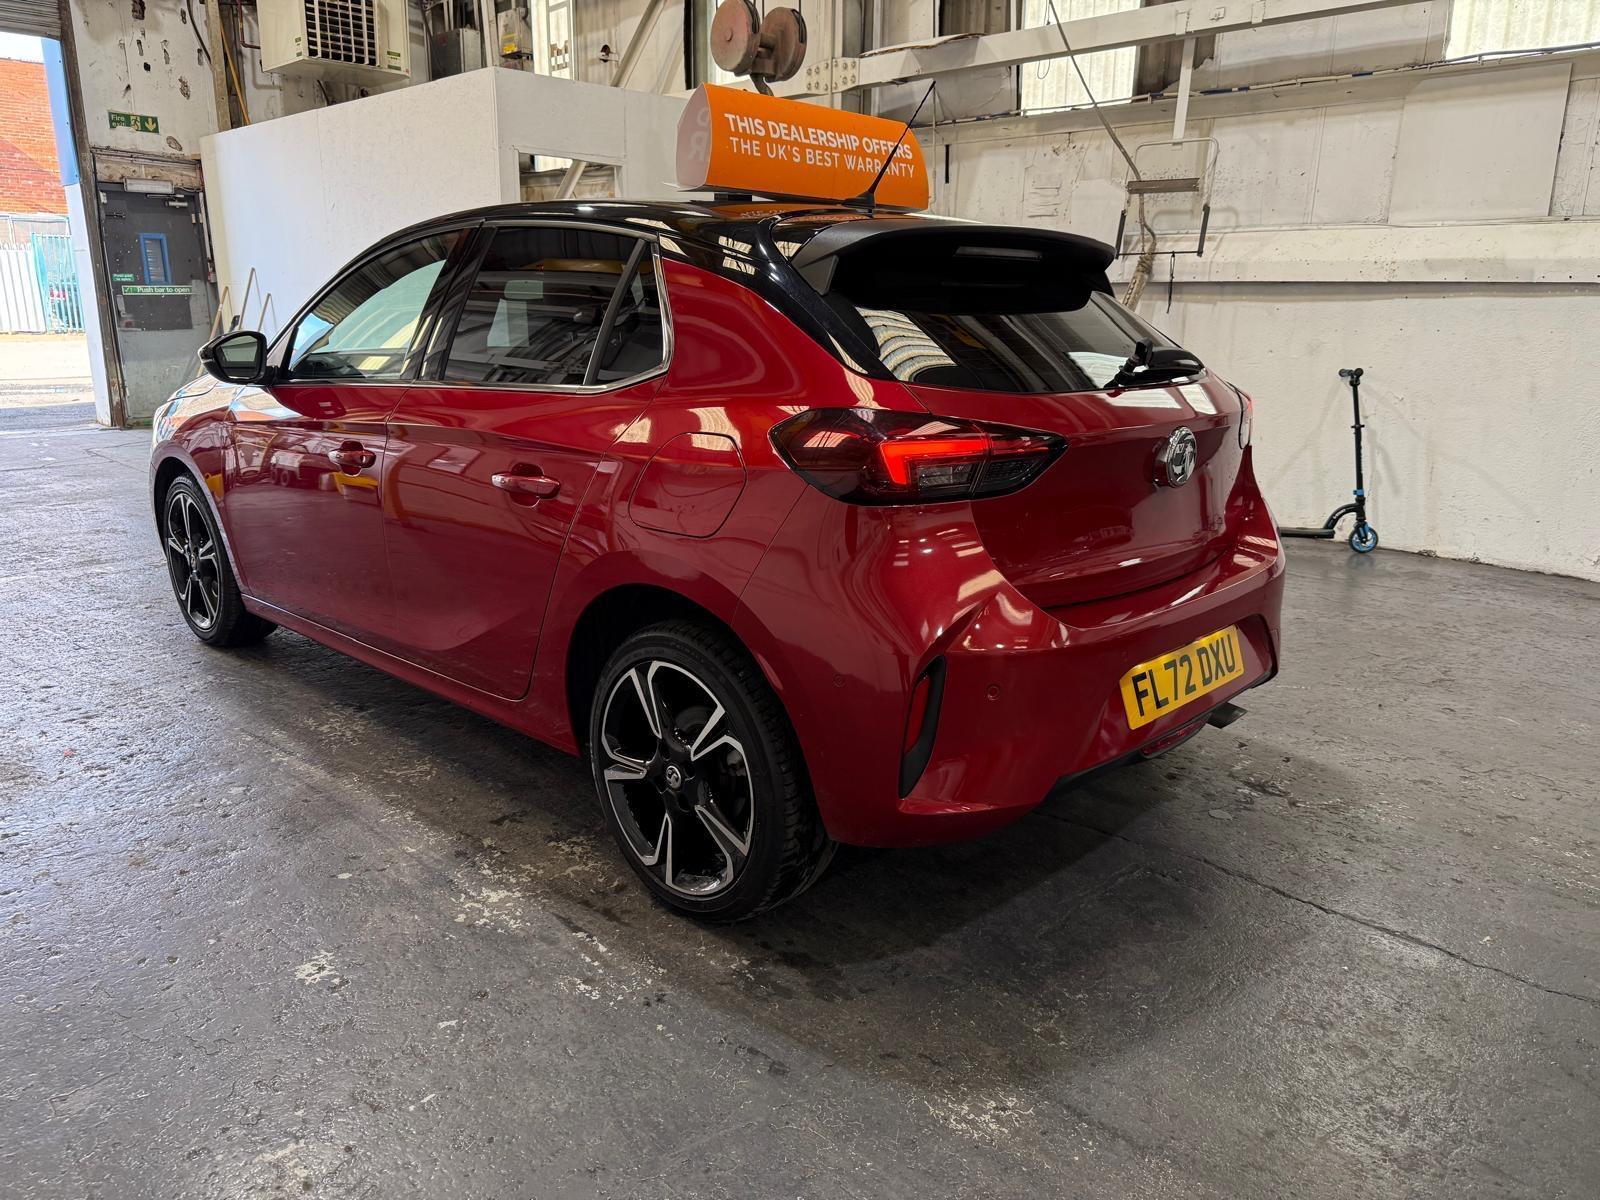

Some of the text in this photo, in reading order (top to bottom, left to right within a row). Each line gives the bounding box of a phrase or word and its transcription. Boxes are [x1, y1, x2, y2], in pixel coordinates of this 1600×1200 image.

[724, 113, 766, 137] THIS
[767, 120, 860, 151] DEALERSHIP
[862, 137, 913, 160] OFFERS
[729, 137, 762, 157] THE
[766, 142, 801, 163] UK'S
[805, 149, 841, 169] BEST
[1132, 634, 1236, 717] FL72 DXU
